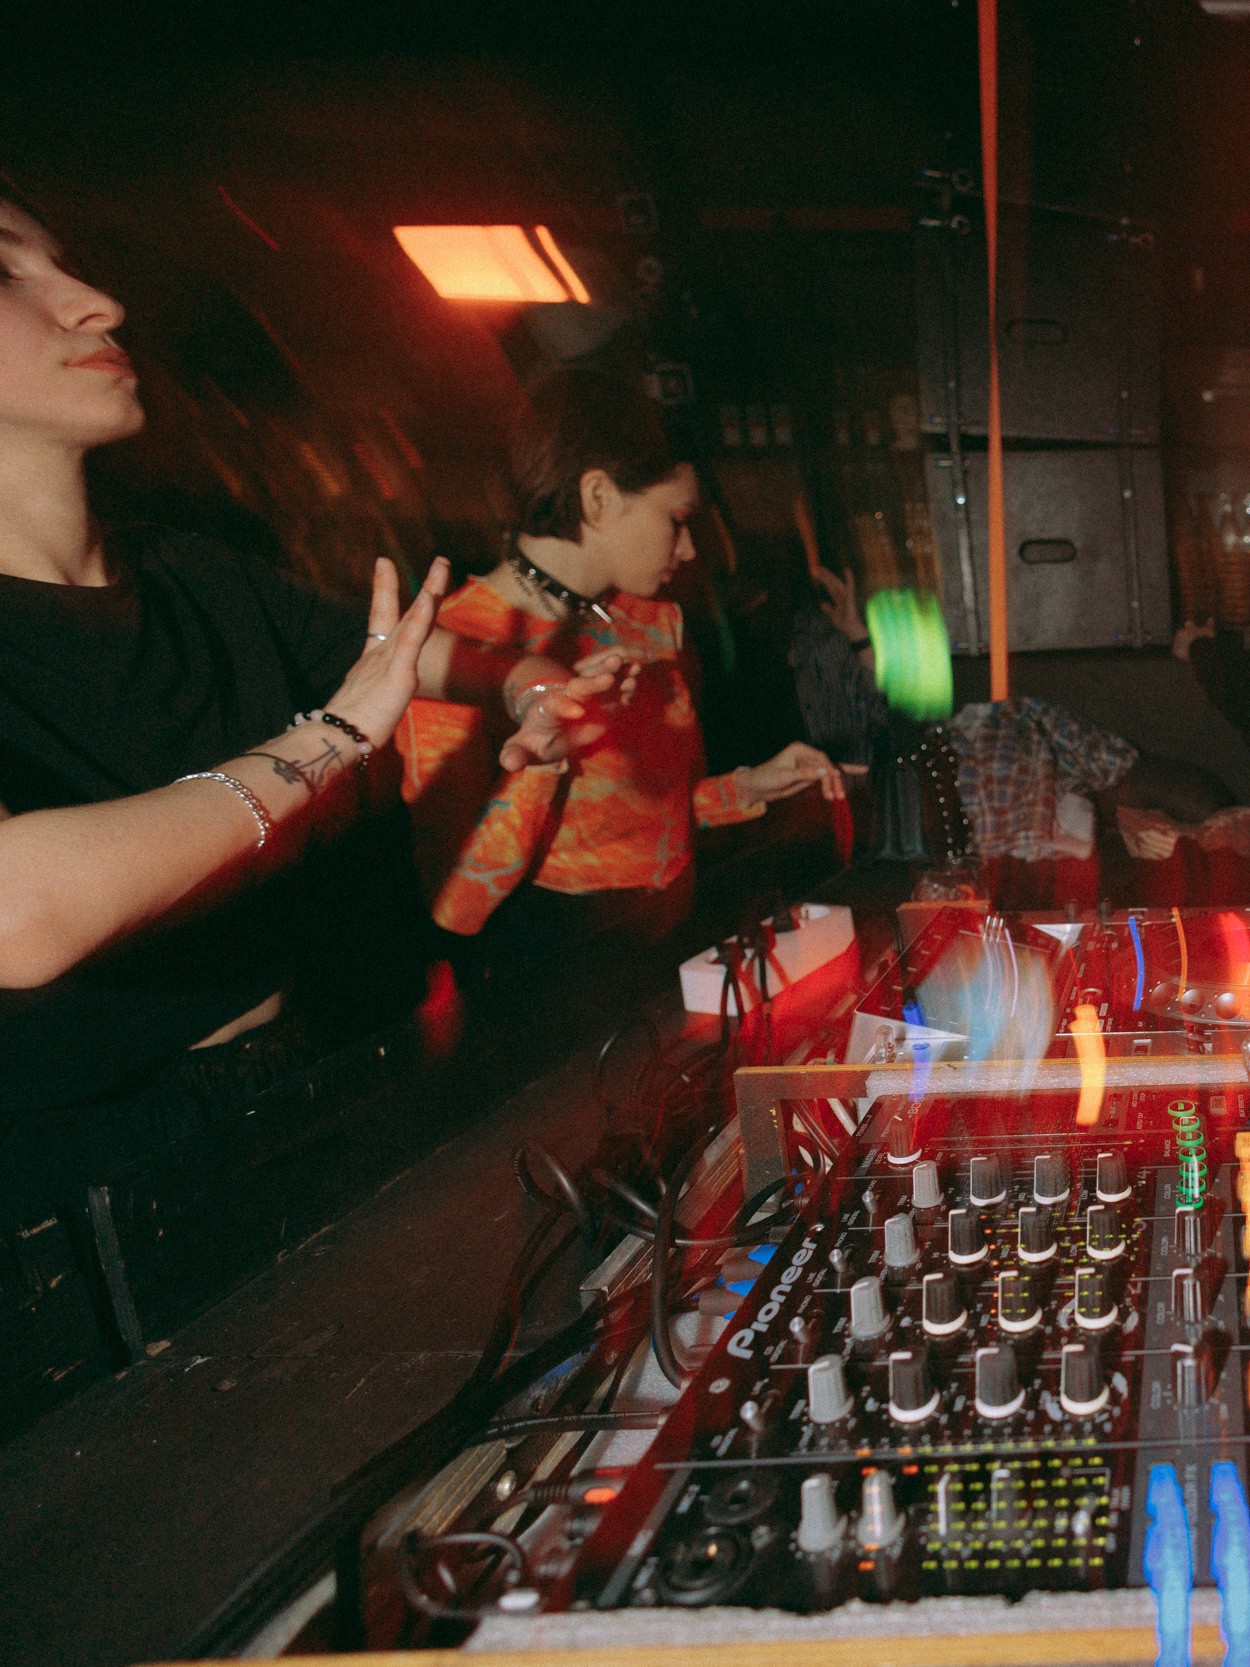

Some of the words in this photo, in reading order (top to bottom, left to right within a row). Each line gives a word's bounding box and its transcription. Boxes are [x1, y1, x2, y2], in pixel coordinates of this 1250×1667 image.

[1162, 1139, 1171, 1158] BALANCE
[1163, 1183, 1171, 1200] COLOR
[1160, 1237, 1169, 1257] COLOR
[726, 1236, 818, 1360] Pioneer
[1155, 1300, 1165, 1325] COLOR
[1150, 1380, 1161, 1410] COLOR
